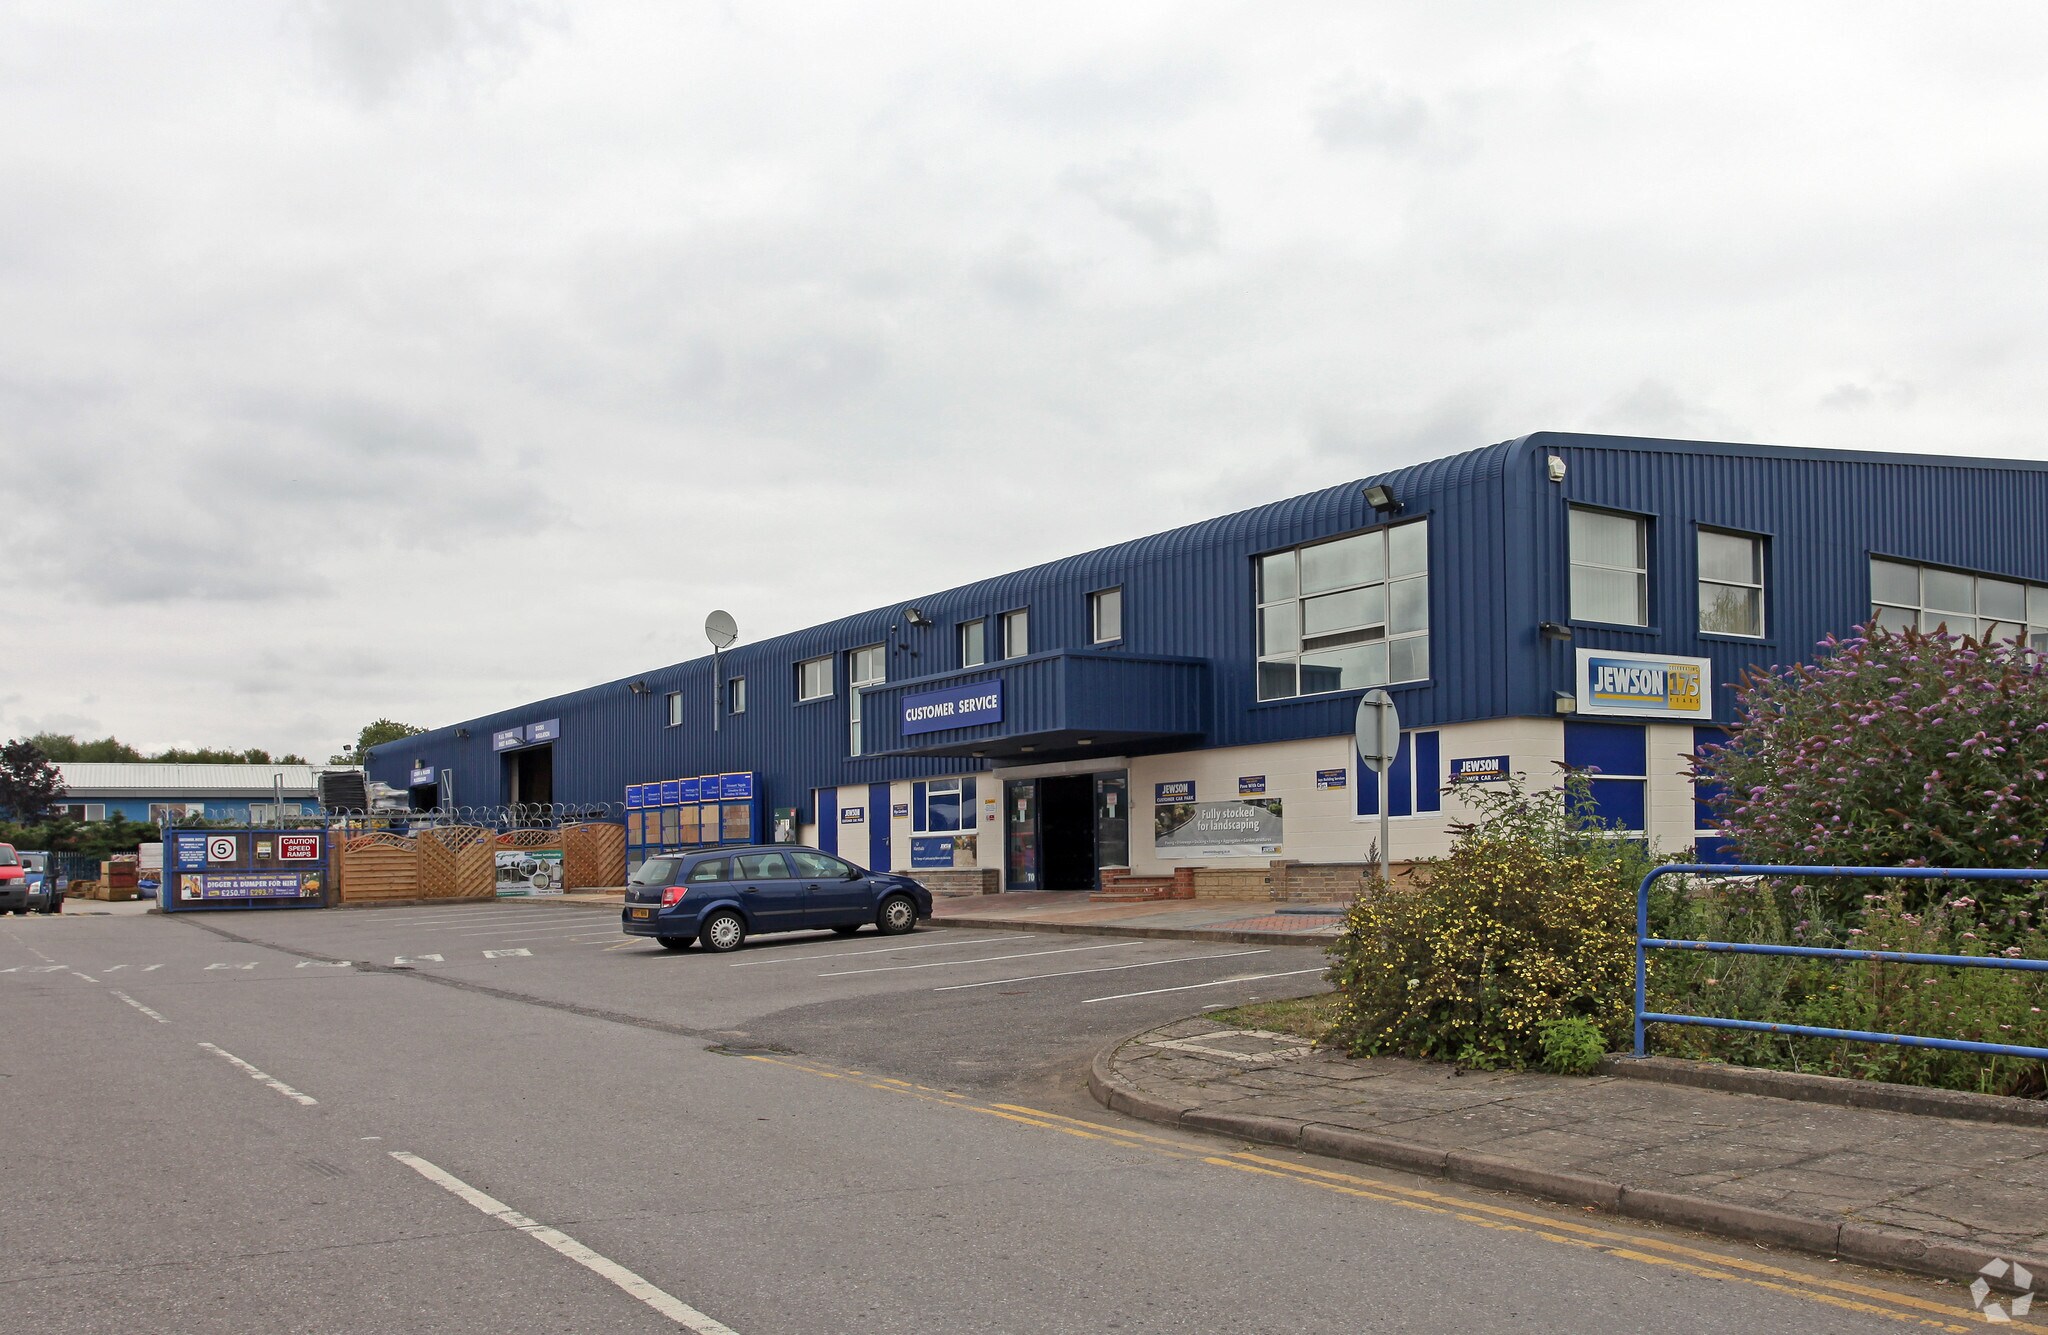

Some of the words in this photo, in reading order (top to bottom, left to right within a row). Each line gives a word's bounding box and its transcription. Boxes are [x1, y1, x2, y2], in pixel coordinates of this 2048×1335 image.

[1594, 666, 1664, 695] JEWSON
[1669, 672, 1699, 697] 175
[905, 702, 955, 722] CUSTOMER
[958, 694, 998, 714] SERVICE
[1460, 759, 1499, 773] JEWSON
[1162, 783, 1188, 794] JEWSON
[844, 808, 860, 817] JEWSON
[1201, 809, 1220, 820] Fully
[1222, 807, 1255, 819] stocked
[1197, 821, 1210, 831] for
[1210, 819, 1260, 832] landscaping
[217, 843, 227, 855] 5
[240, 880, 268, 888] DUMPER
[268, 880, 282, 888] FOR
[282, 879, 298, 887] HIRE
